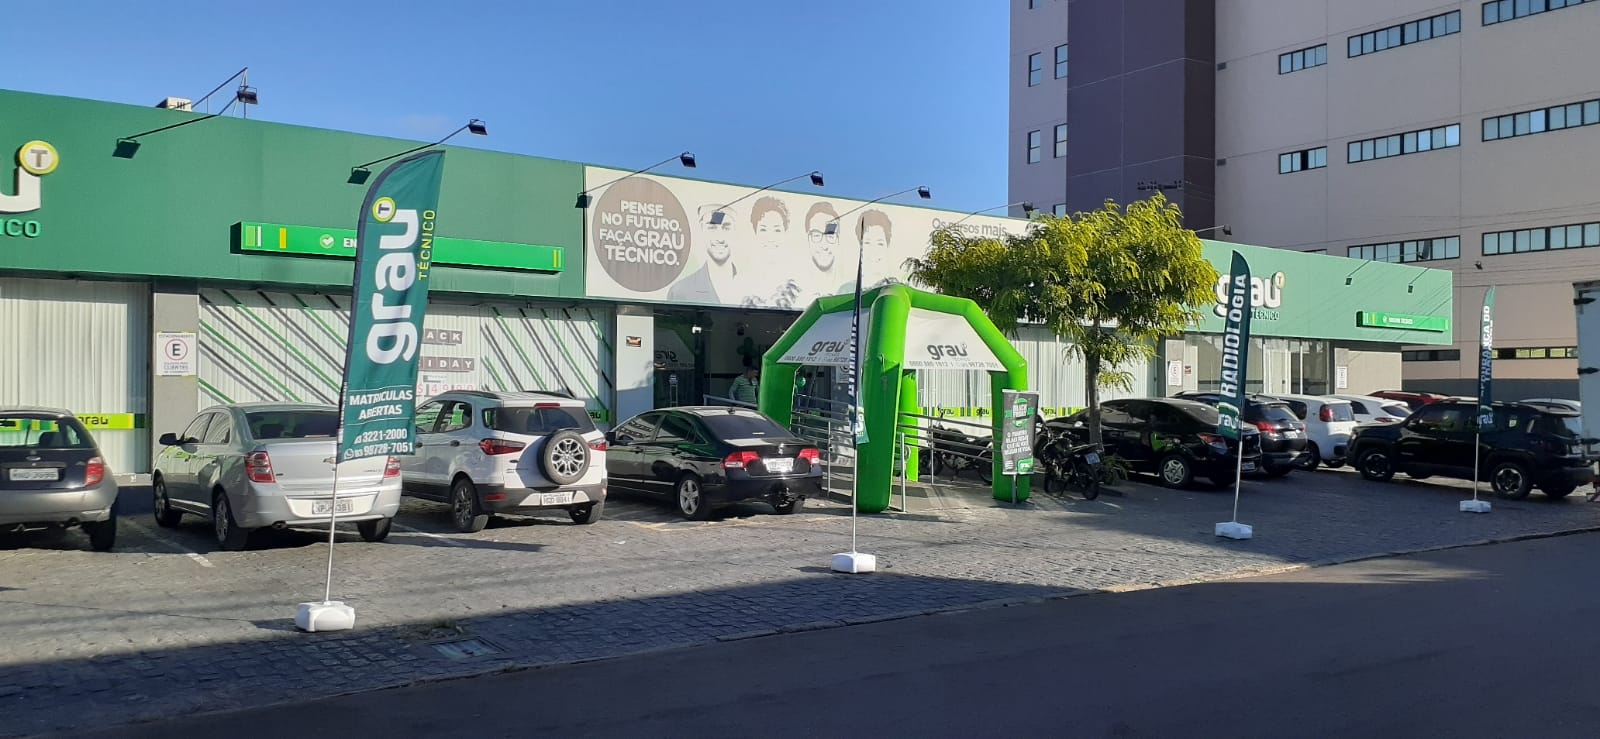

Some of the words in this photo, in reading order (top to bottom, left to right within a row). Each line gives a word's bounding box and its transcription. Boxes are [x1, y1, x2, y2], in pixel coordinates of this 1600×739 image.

[620, 199, 664, 217] PENSE
[601, 211, 622, 226] NO
[625, 214, 682, 232] FUTURO.
[981, 223, 1009, 238] mais
[343, 238, 357, 249] EN
[418, 209, 436, 281] TÉCNICO
[600, 228, 633, 243] FAÇA
[634, 229, 685, 250] GRAU
[604, 242, 680, 266] TÉCNICO.
[366, 209, 419, 364] grau
[426, 331, 461, 341] ACK
[1220, 273, 1247, 398] RADIOLOGIA
[172, 343, 181, 357] E
[808, 340, 845, 356] grau
[927, 344, 968, 361] grau
[420, 359, 472, 369] IDAY
[358, 404, 403, 420] ABERTAS
[362, 428, 408, 443] 3221-2000
